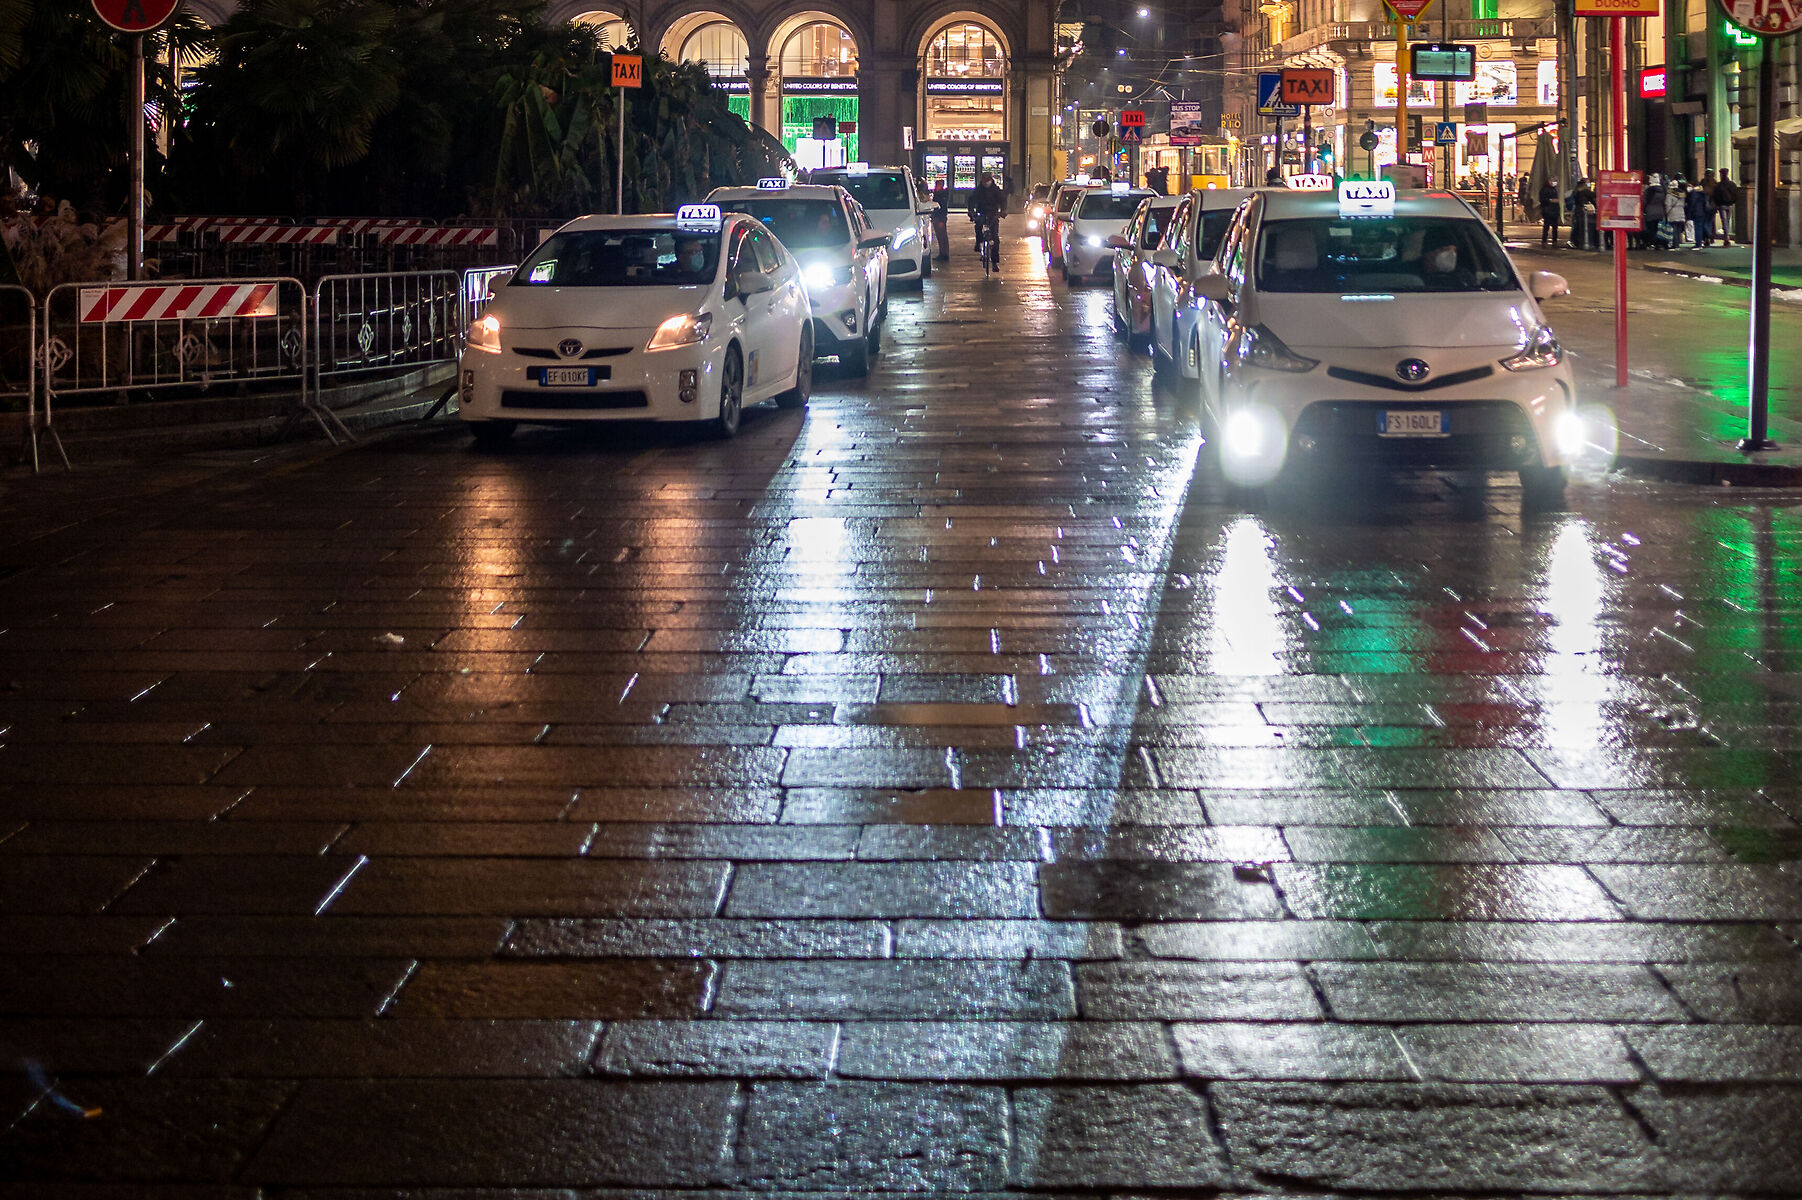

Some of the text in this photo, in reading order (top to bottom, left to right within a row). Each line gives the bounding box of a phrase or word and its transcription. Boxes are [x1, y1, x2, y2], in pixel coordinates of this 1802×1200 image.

[1595, 0, 1640, 8] DUOMO
[614, 62, 640, 80] TAXI
[1286, 79, 1329, 94] TAXI
[1125, 114, 1143, 123] TAXI
[1220, 120, 1241, 129] RIO
[1424, 150, 1435, 160] M
[760, 180, 785, 188] TAXI
[1294, 178, 1328, 188] TAXI
[1346, 186, 1390, 199] TAXI
[682, 208, 716, 219] TAXI
